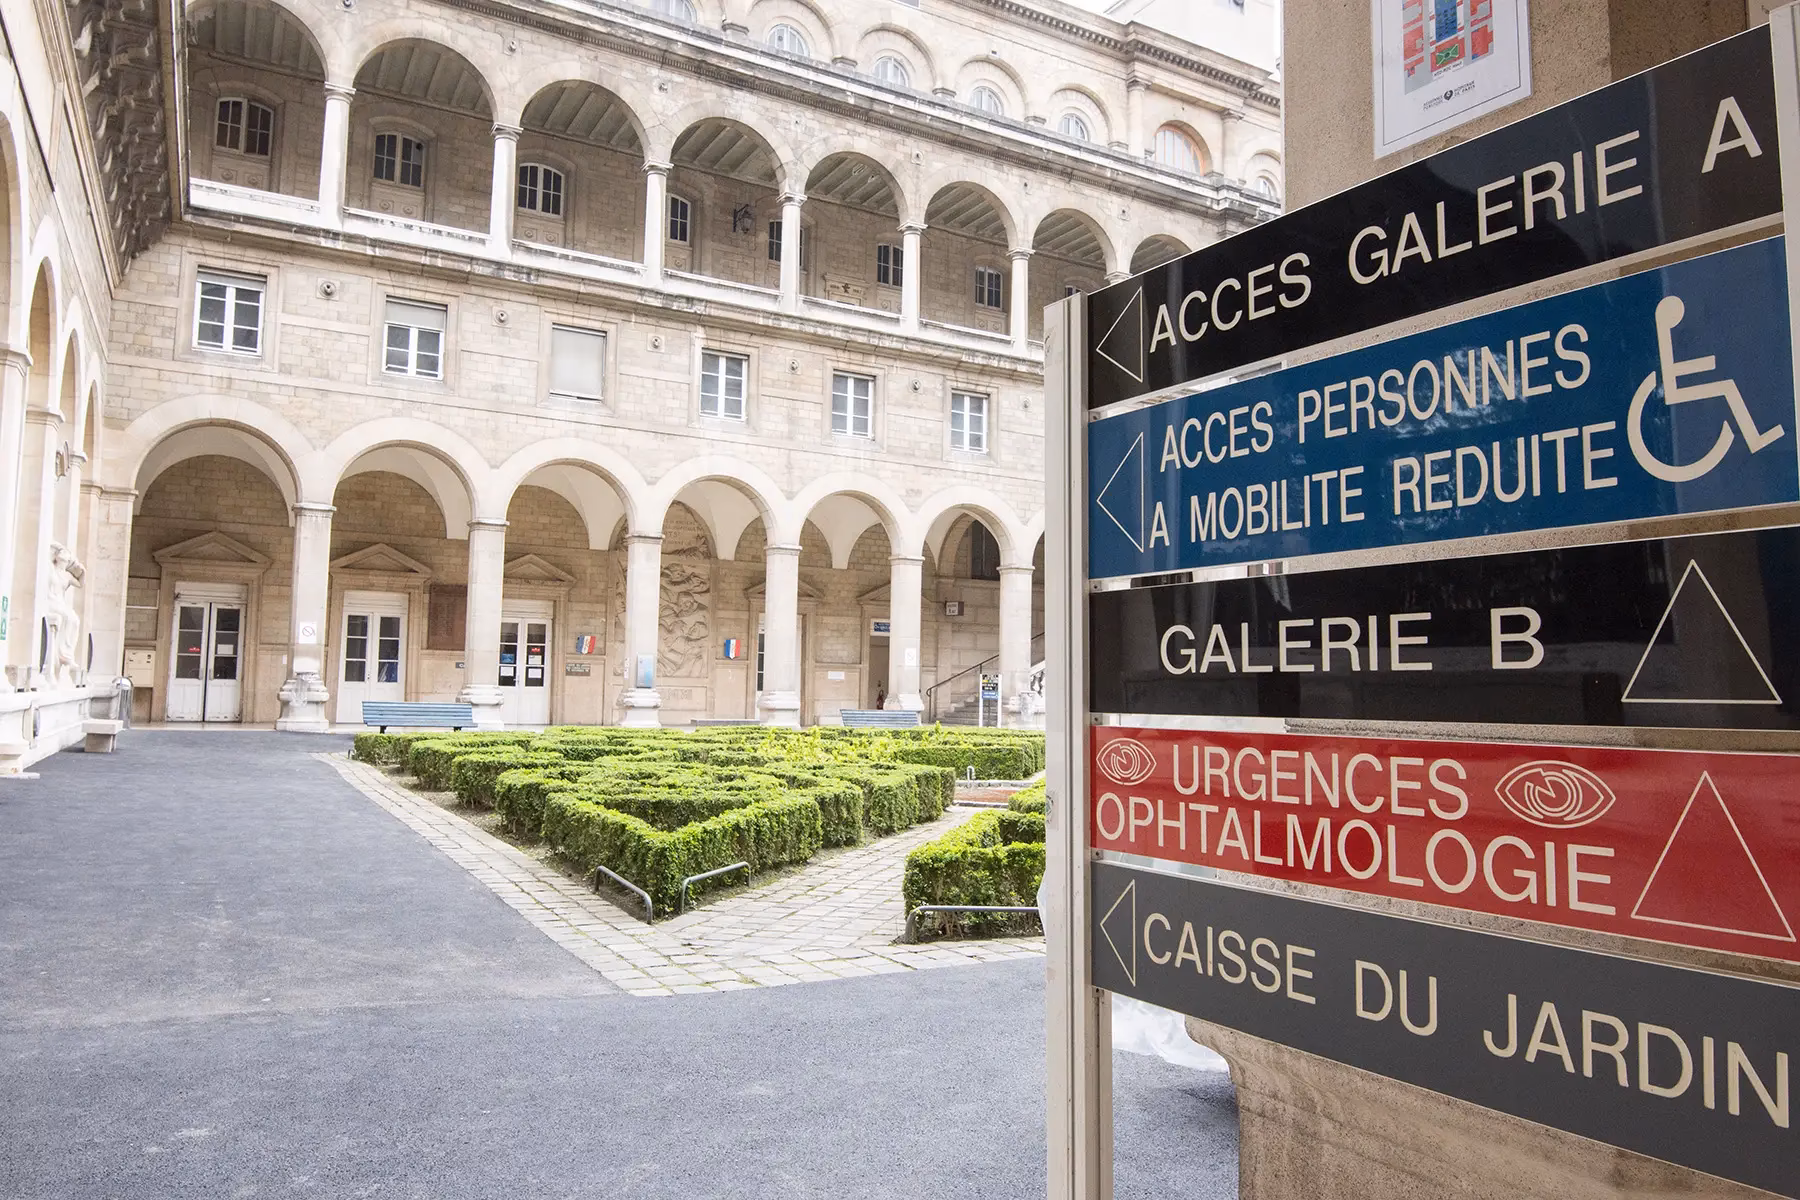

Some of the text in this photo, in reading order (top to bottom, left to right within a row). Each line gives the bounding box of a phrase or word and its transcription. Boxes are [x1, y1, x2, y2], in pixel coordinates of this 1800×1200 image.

[1150, 97, 1762, 353] ACCES GALERIE A
[1160, 324, 1590, 472] ACCES PERSONNES
[1150, 421, 1617, 548] A MOBILITE REDUITE
[1161, 607, 1544, 674] GALERIE B
[1173, 744, 1468, 820] URGENCES
[1097, 792, 1616, 915] OPHTALMOLOGIE
[1144, 913, 1789, 1128] CAISSE DU JARDIN
